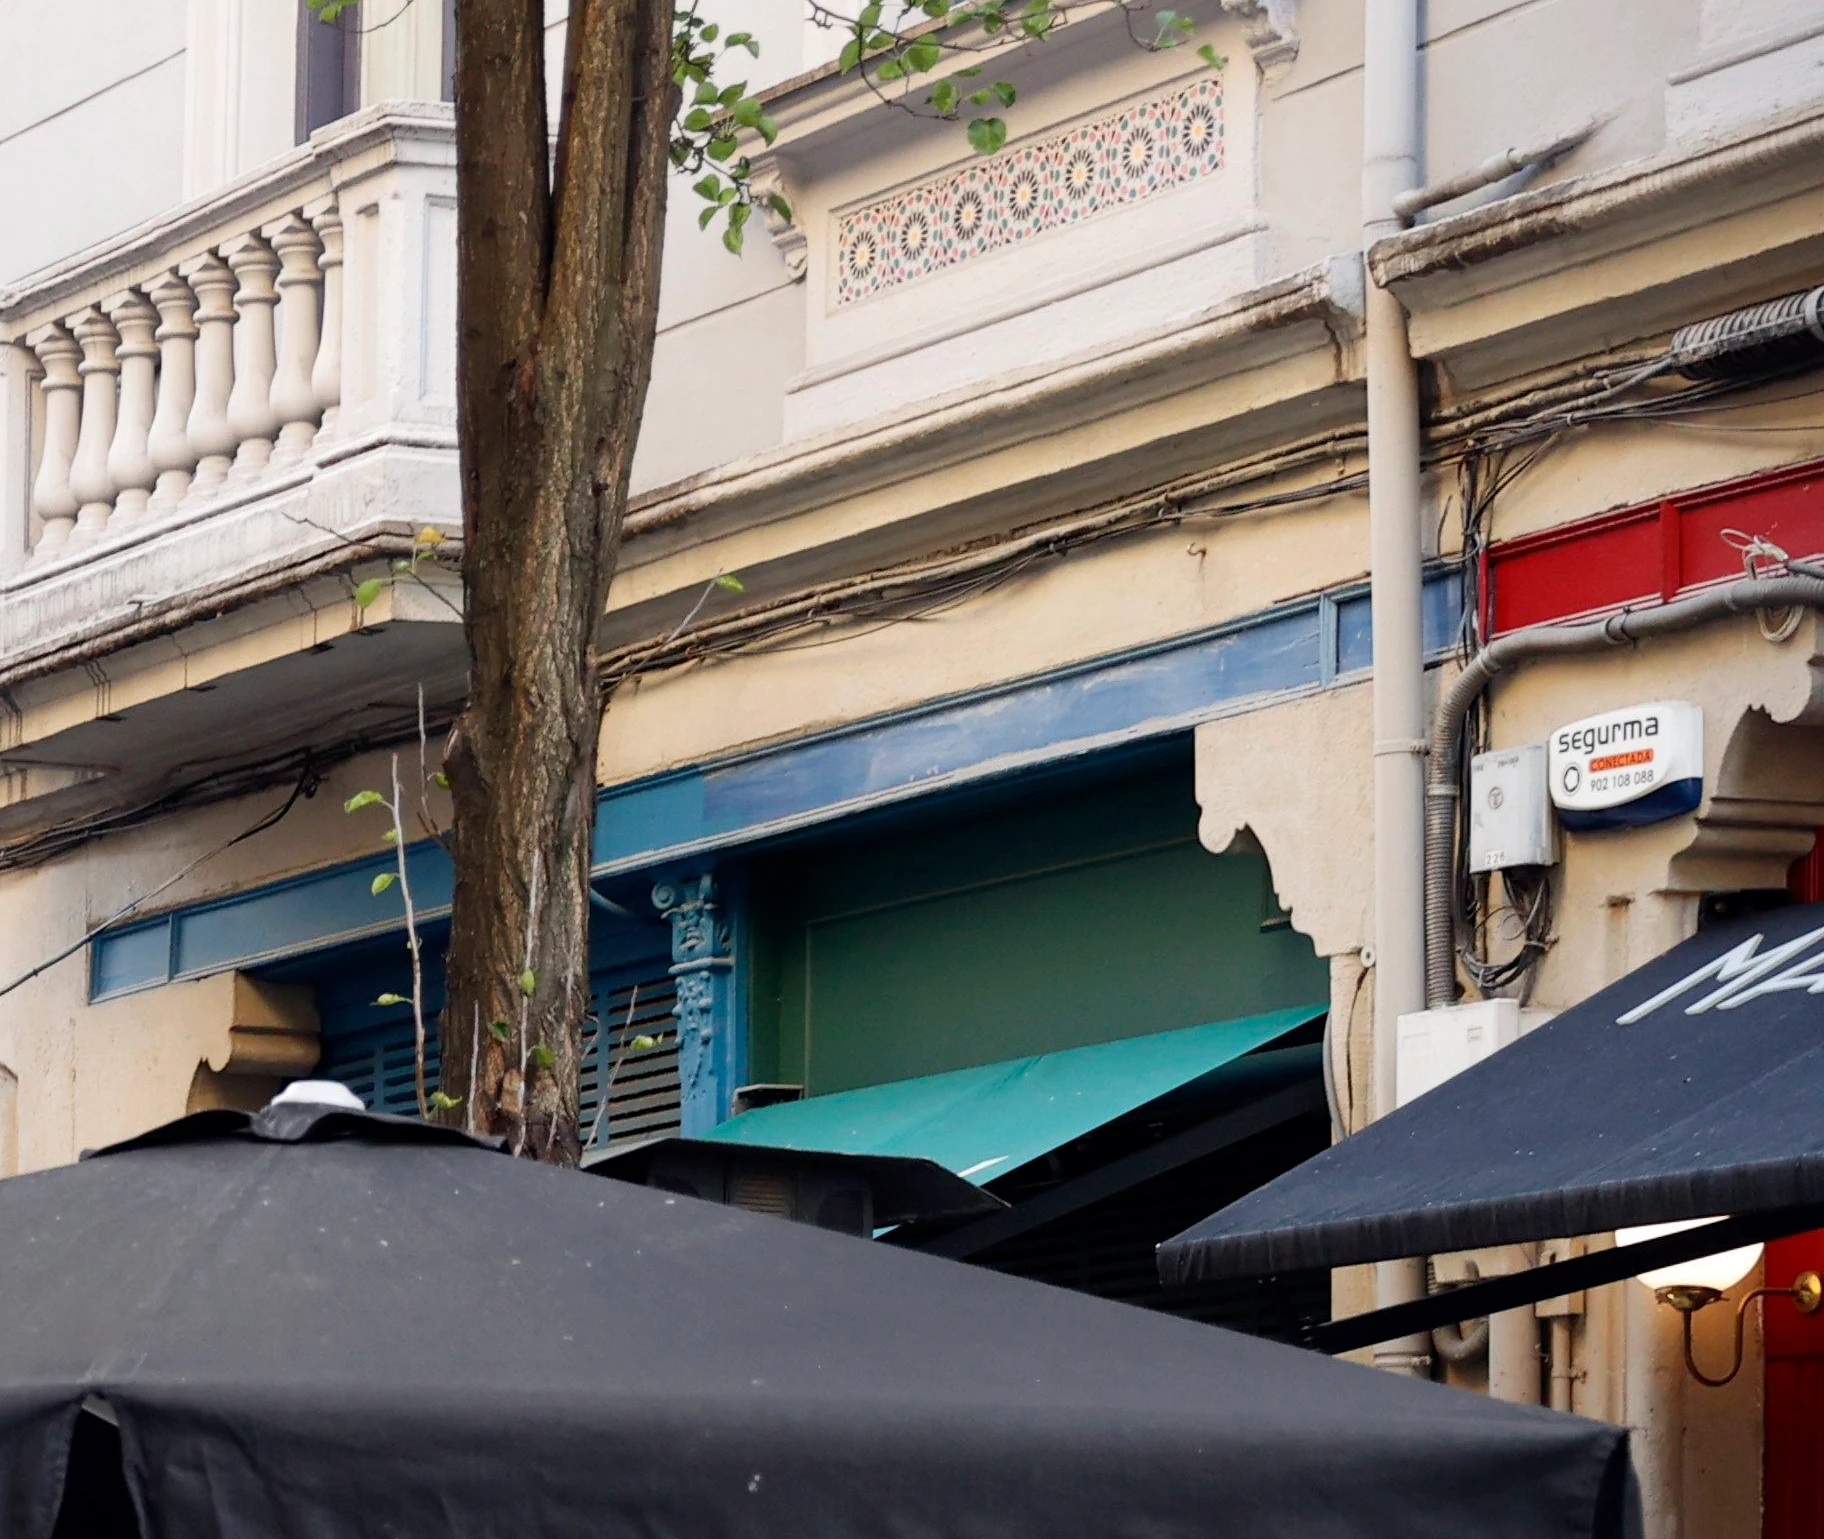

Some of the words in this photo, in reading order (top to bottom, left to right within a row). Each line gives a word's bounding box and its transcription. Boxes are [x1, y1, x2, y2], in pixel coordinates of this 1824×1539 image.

[1558, 715, 1659, 755] segurma
[1591, 751, 1652, 771] CONECTADA
[1590, 776, 1609, 791] 902
[1612, 773, 1631, 787] 108
[1634, 769, 1654, 784] 088
